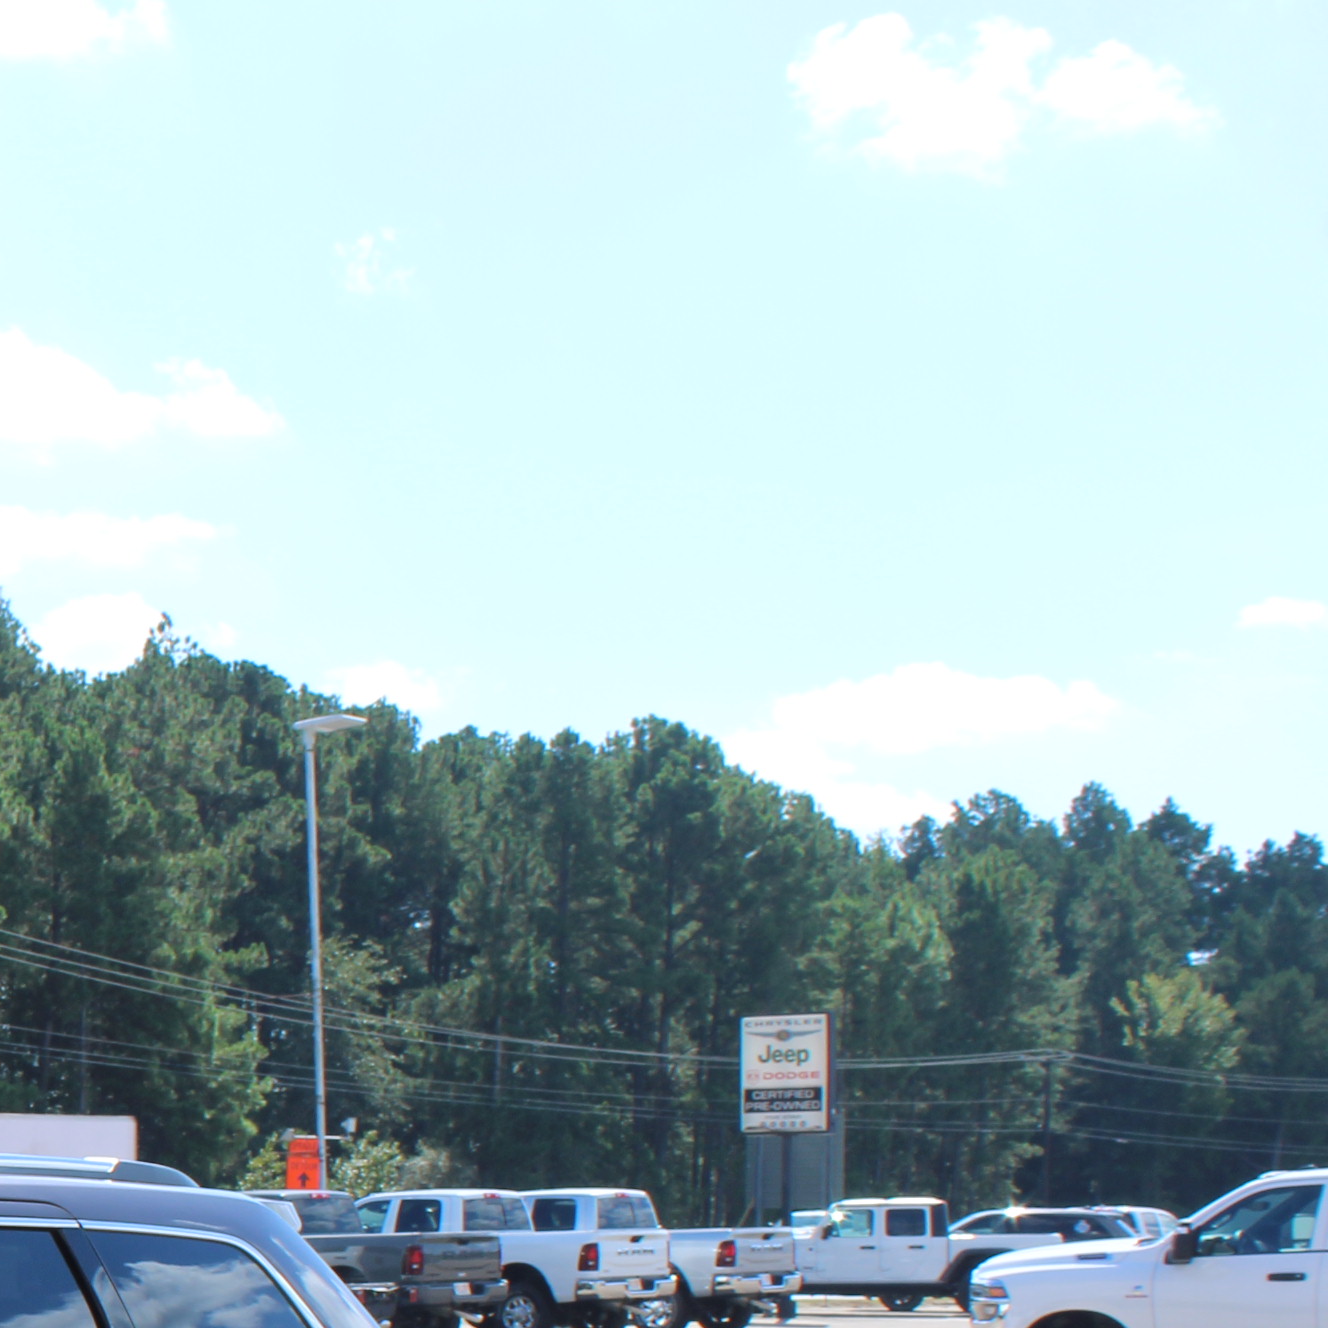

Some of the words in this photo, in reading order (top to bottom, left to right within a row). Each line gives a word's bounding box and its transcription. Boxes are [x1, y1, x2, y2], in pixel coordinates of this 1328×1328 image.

[744, 1019, 823, 1028] CHRYSLER
[758, 1044, 810, 1066] Jeep
[763, 1071, 820, 1080] DODGE
[752, 1090, 815, 1100] CERTIFIED
[745, 1101, 820, 1112] PRE-OWNED
